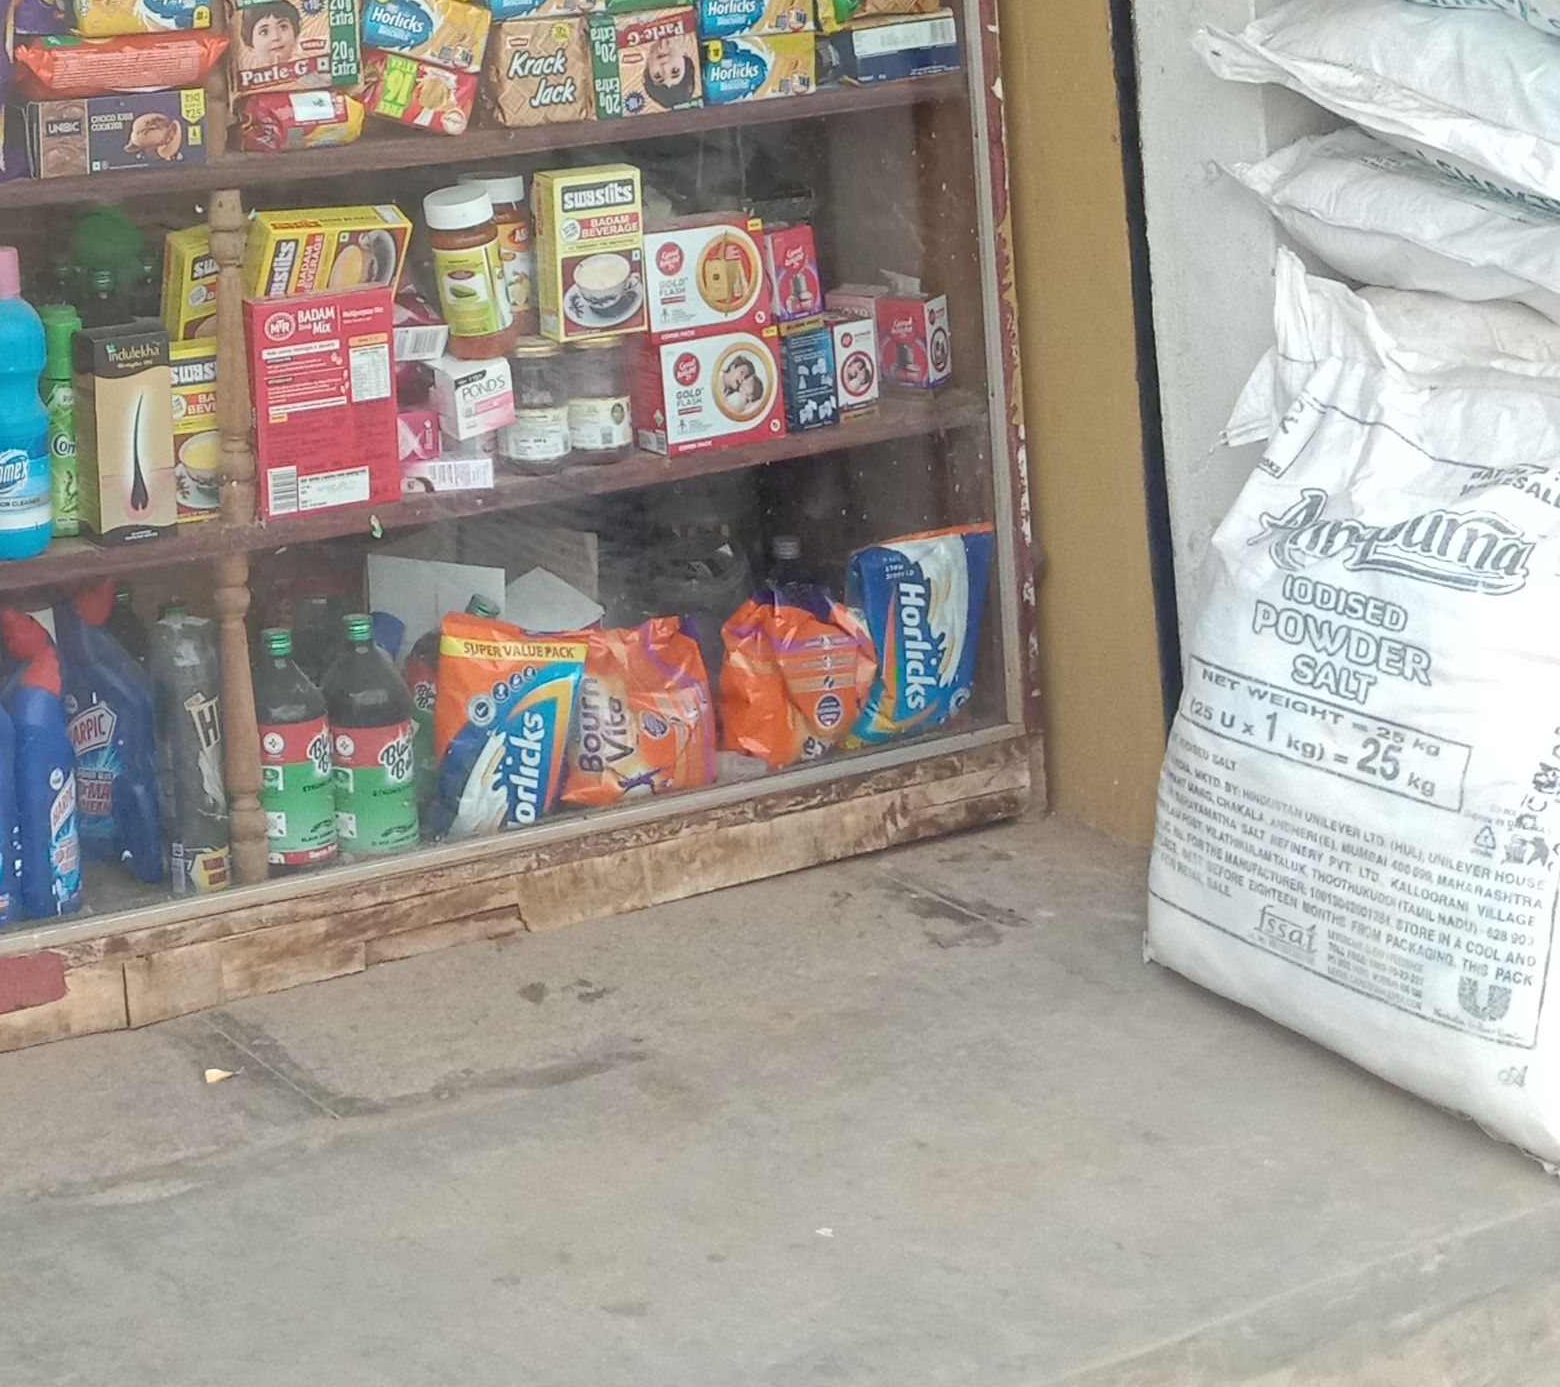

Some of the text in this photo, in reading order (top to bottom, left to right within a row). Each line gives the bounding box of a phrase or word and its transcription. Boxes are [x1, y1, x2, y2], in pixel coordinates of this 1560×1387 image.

[371, 8, 426, 35] Horlicks
[707, 0, 757, 19] Horlicks
[240, 59, 309, 88] Parle-G
[507, 51, 567, 78] Krack
[710, 63, 760, 82] Horlicks
[530, 80, 576, 109] Jack
[47, 120, 81, 135] UNIBIC
[581, 221, 640, 239] BEVERAGE
[590, 215, 630, 228] BADAM
[297, 307, 335, 324] BADAM
[1282, 573, 1408, 633] IODISED
[463, 640, 577, 660] SUPER VALUE PACK
[898, 581, 928, 712] Horlicks
[1251, 600, 1433, 687] POWDER
[1291, 653, 1378, 706] SALT
[1201, 668, 1238, 691] NET
[1247, 685, 1344, 727] WEIGHT
[1411, 736, 1442, 759] kg
[1220, 707, 1237, 729] U
[1265, 711, 1280, 742] 1
[1286, 731, 1326, 762] kg)
[1356, 737, 1401, 783] 25
[1407, 771, 1436, 798] kg
[512, 709, 546, 829] orlicks
